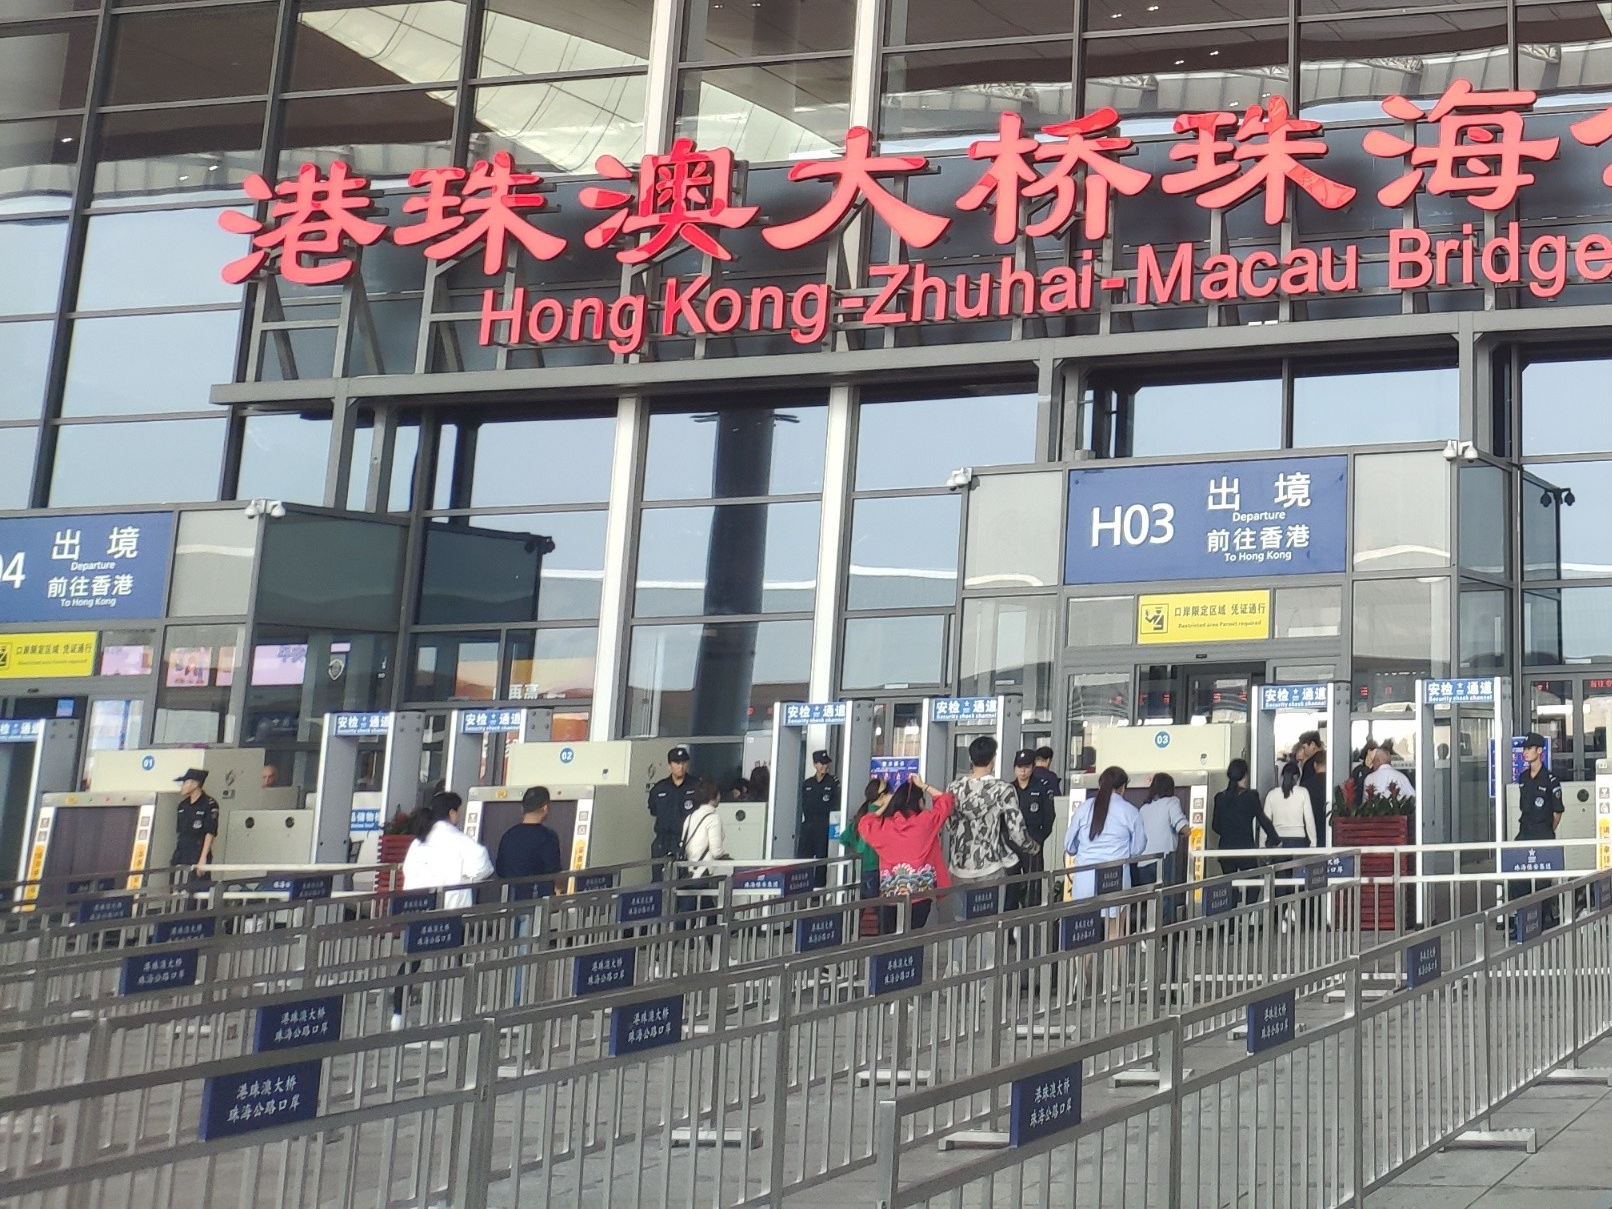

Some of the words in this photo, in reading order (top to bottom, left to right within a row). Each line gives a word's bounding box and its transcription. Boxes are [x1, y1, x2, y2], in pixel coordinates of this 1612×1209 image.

[479, 288, 646, 354] Hong
[1207, 472, 1311, 511] 出境
[1232, 510, 1286, 523] Departure
[1091, 502, 1176, 547] H03
[51, 526, 140, 562] 出境
[1206, 524, 1310, 553] 前往香港
[1224, 553, 1237, 562] To
[1238, 551, 1265, 563] Hong
[1267, 549, 1292, 561] Kong
[0, 551, 26, 589] 4
[70, 560, 116, 572] Departure
[47, 573, 134, 599] 前往香港
[60, 598, 71, 608] To
[71, 597, 94, 609] Hong
[96, 596, 117, 608] Kong
[1174, 604, 1226, 616] 口岸限定区域
[1231, 602, 1266, 616] 凭证通行
[1265, 688, 1289, 702] 安检
[1302, 686, 1326, 700] 通道
[1428, 681, 1453, 696] 安检
[1467, 680, 1492, 695] 通道
[788, 704, 810, 718] 安检
[823, 704, 846, 718] 通道
[936, 700, 960, 714] 安检
[973, 699, 997, 713] 通道
[338, 715, 359, 728] 安检
[369, 715, 390, 728] 通道
[465, 712, 488, 726] 安检
[499, 711, 521, 725] 通道
[1156, 734, 1170, 745] 03
[561, 750, 573, 760] 02
[236, 1074, 298, 1101] 港珠澳大桥
[226, 1093, 301, 1124] 珠海公路口岸
